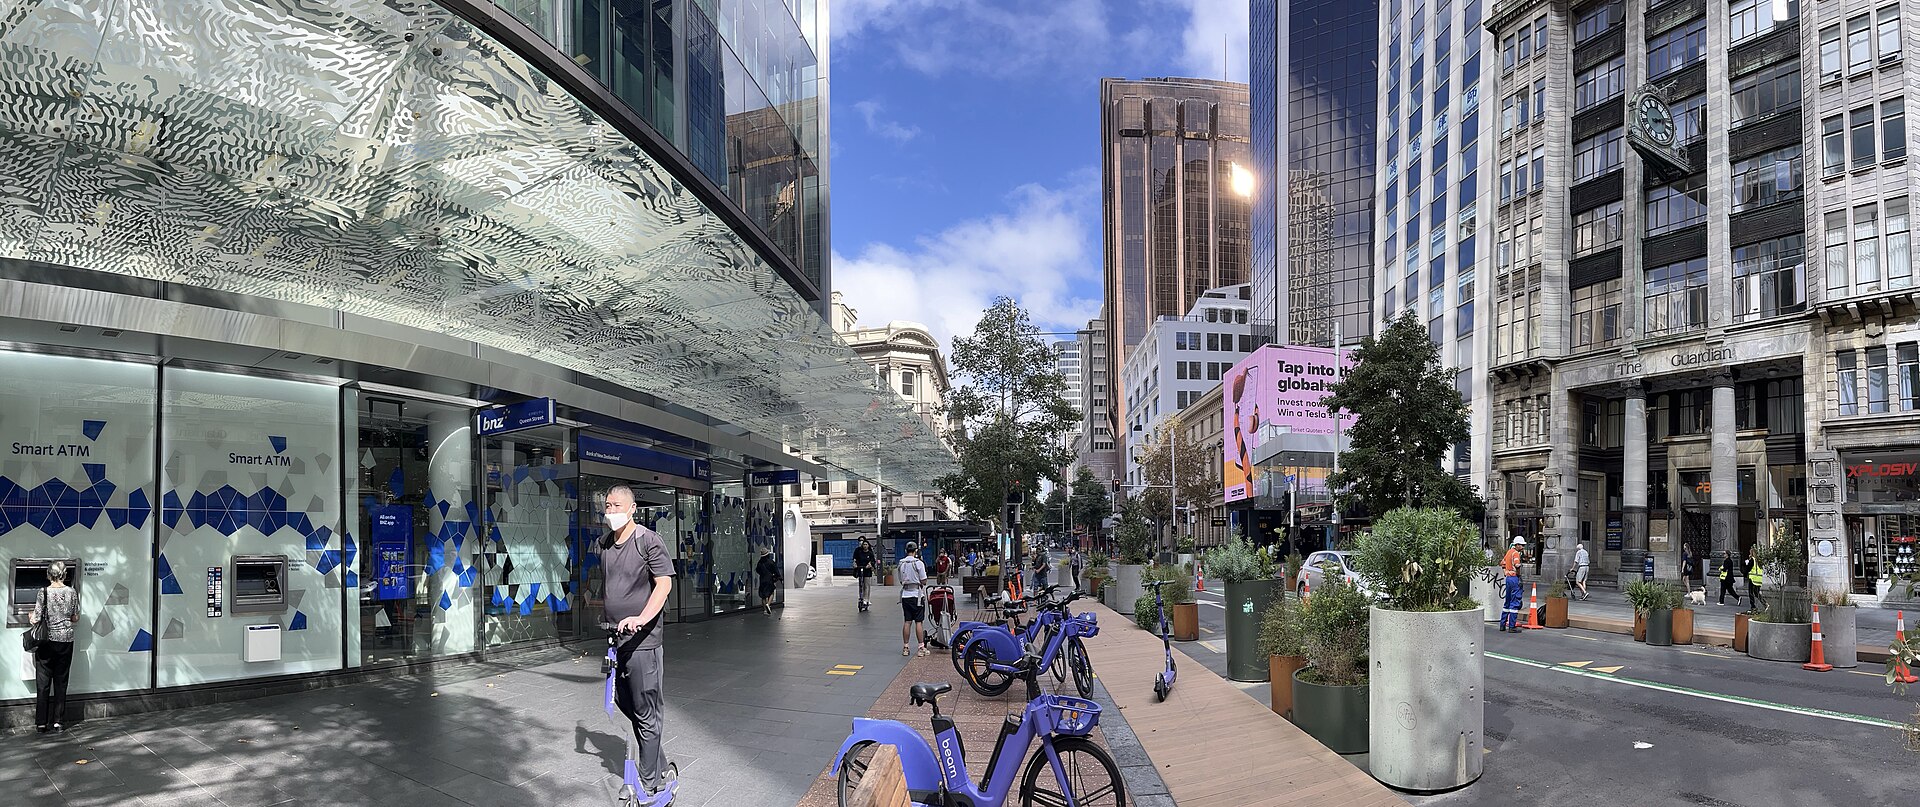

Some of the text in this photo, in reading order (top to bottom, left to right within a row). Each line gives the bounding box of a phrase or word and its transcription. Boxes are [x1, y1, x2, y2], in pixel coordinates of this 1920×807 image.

[1277, 360, 1304, 377] Tap
[1307, 362, 1335, 377] into
[1617, 348, 1732, 376] The Guardian
[1277, 377, 1324, 393] global
[1277, 397, 1304, 407] Invest
[1277, 408, 1295, 417] Win
[1305, 409, 1327, 419] Tesla
[482, 416, 504, 431] bnz
[11, 442, 90, 457] Smart ATM
[228, 452, 291, 467] Smart ATM
[698, 466, 708, 477] bnz
[1847, 462, 1918, 478] XPLOSIV
[753, 475, 769, 485] bnz
[941, 737, 958, 779] beam
